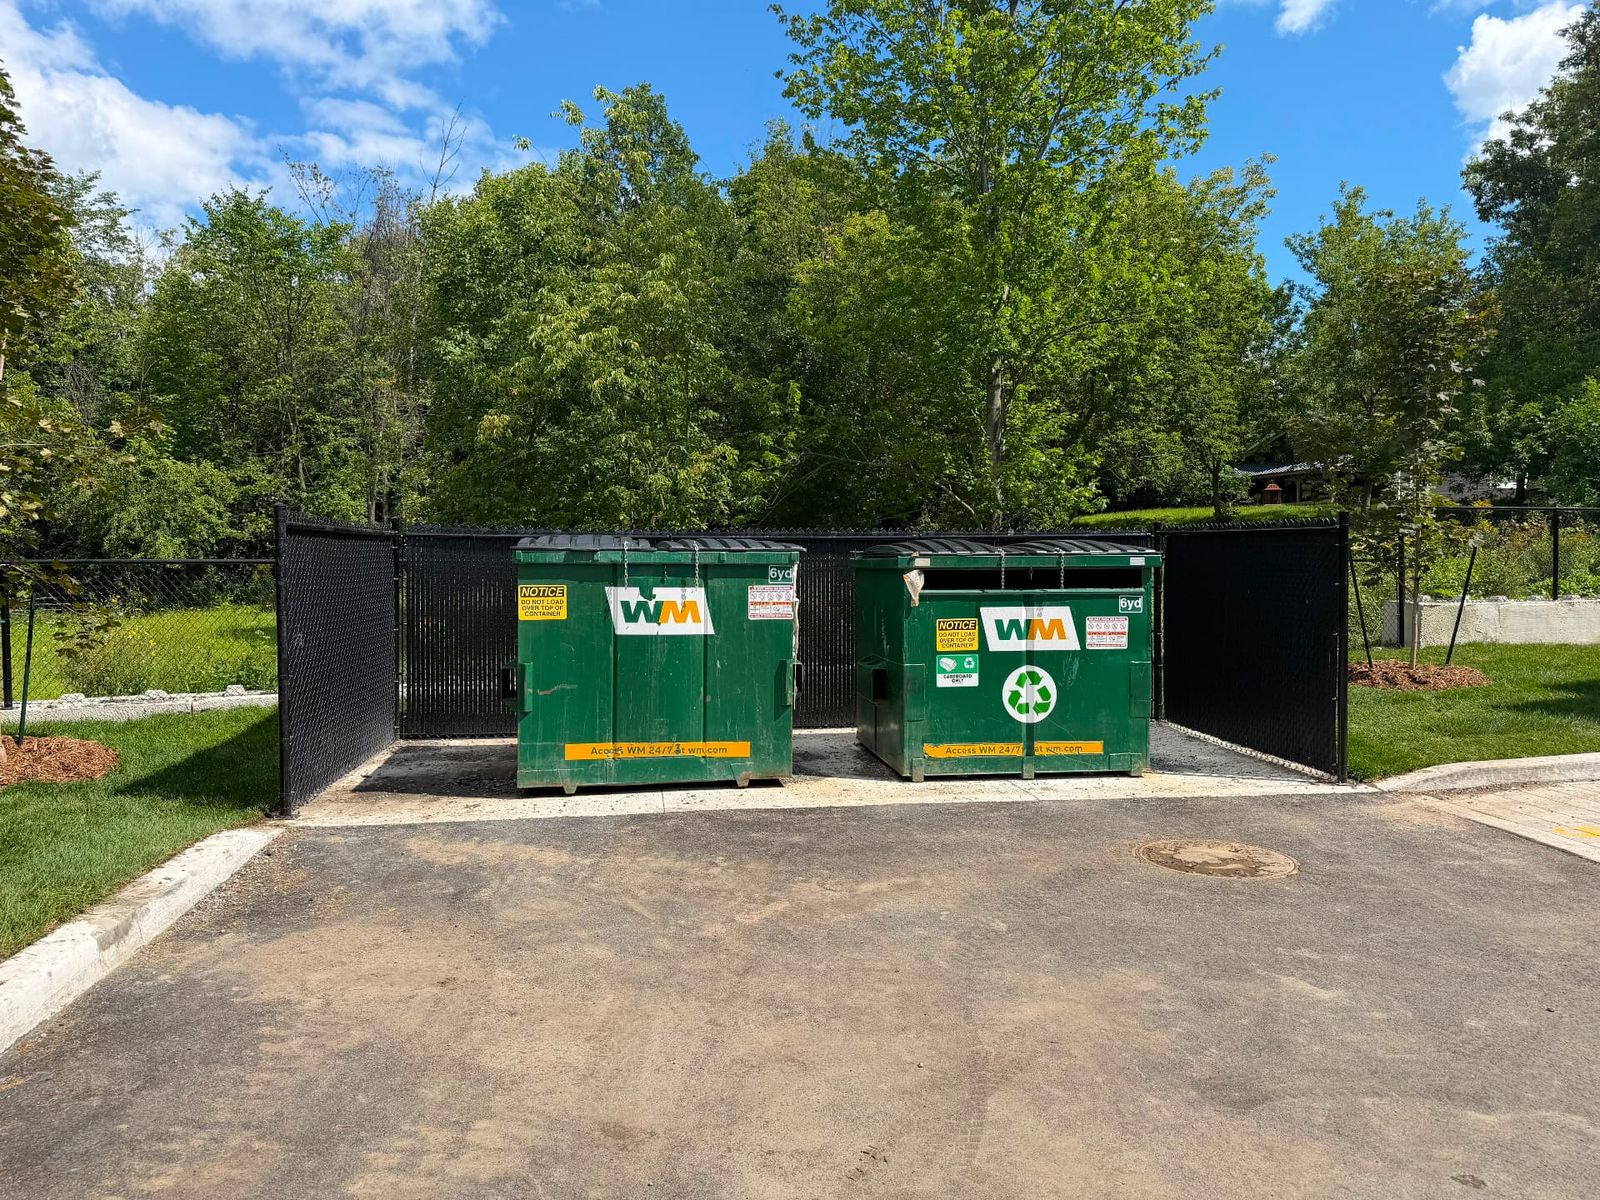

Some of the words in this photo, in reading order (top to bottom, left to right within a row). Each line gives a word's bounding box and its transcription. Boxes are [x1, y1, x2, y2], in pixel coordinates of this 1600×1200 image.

[770, 567, 793, 581] 6yd
[521, 587, 564, 597] NOTICE
[1120, 597, 1142, 611] 6yd
[620, 601, 701, 623] WM
[939, 620, 976, 630] NOTICE
[994, 619, 1066, 640] WM
[626, 746, 646, 754] WM
[648, 745, 673, 754] 24/7
[979, 746, 996, 754] WM
